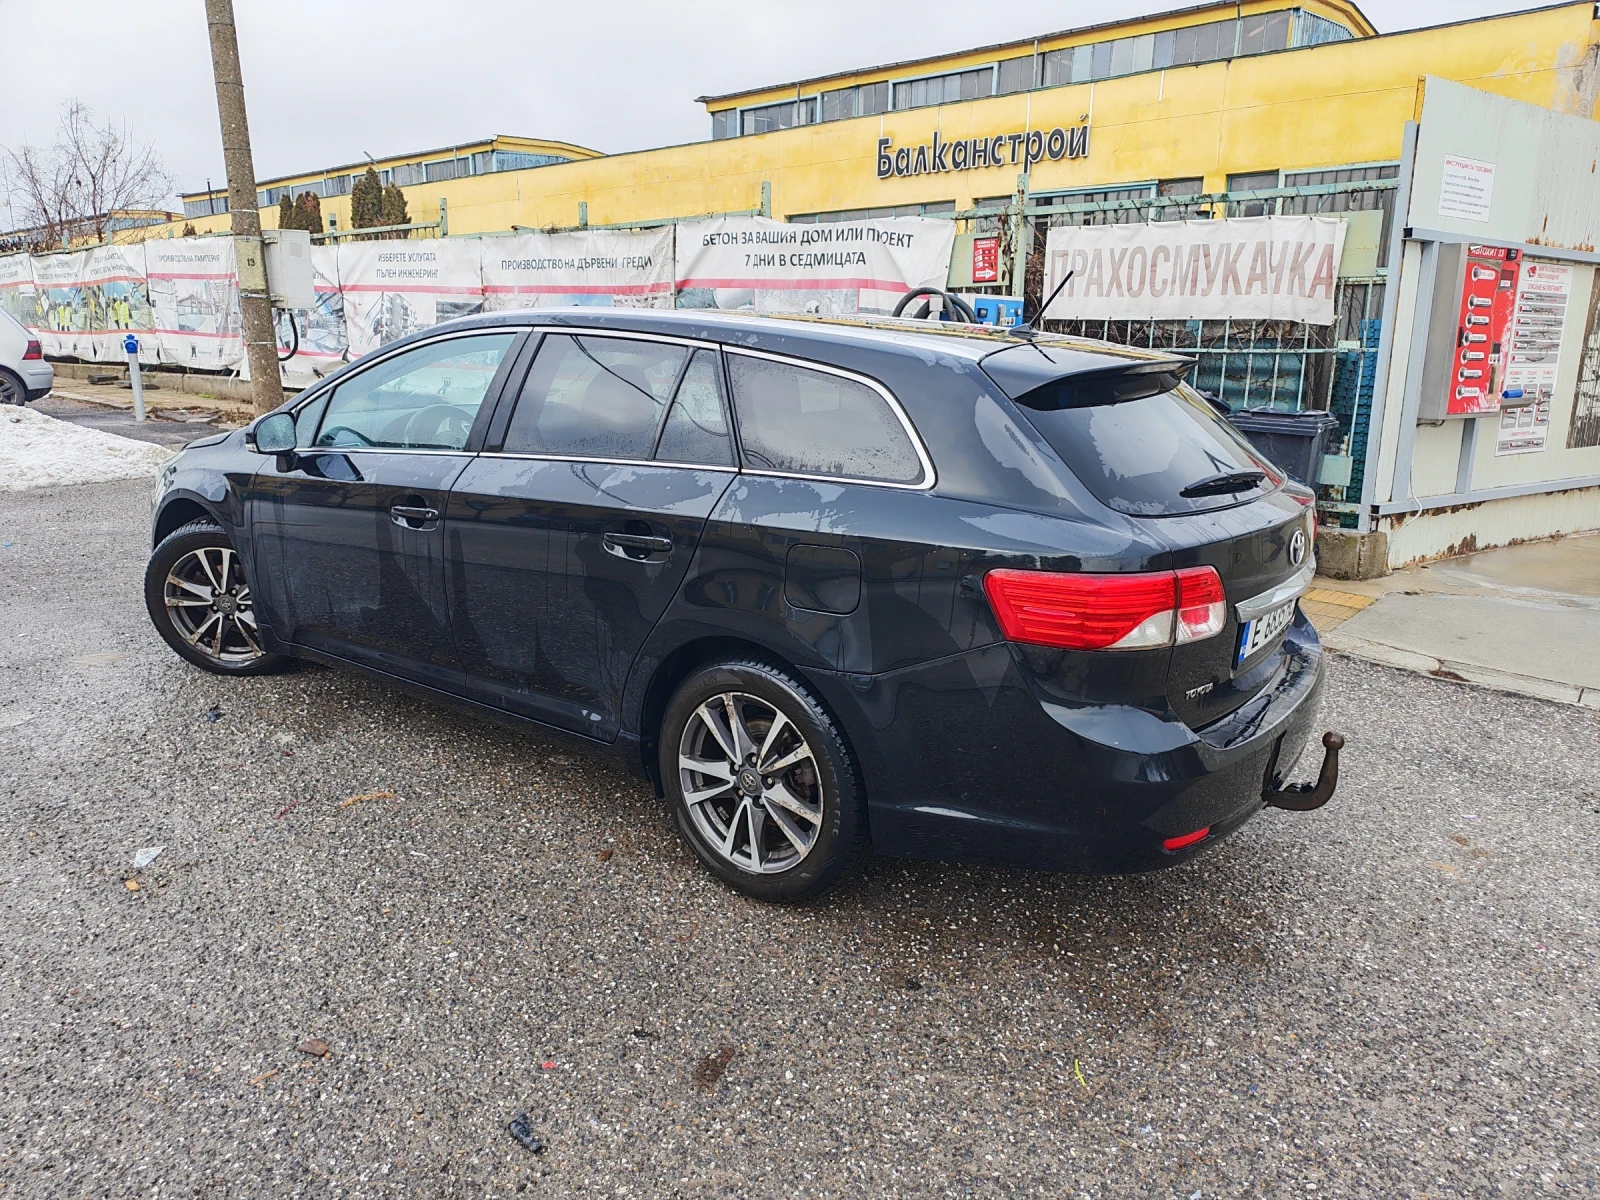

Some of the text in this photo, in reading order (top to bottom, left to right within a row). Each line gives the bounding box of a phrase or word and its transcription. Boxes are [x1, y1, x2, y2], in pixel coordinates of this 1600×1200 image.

[876, 113, 1091, 178] Балканстрой
[703, 232, 738, 246] БЕТОН
[741, 231, 754, 244] ЗА
[756, 230, 797, 244] ВАШИЯ
[800, 229, 832, 246] ДОМ
[836, 227, 863, 242] ИЛИ
[247, 258, 256, 267] 13
[378, 252, 437, 262] ИЗБЕРЕТЕ УСЛУГАТА
[501, 256, 652, 271] ПРОИЗВОДСТВО НА ДЪРВЕНИ ГРЕДИ
[745, 251, 866, 269] 7 ДНИ В СЕДМИЦАТА
[376, 268, 439, 278] ПЪЛЕН ИНЖЕНЕРИНГ
[1050, 239, 1334, 301] ПРАХОСМУКАЧКА
[1251, 616, 1263, 649] E
[1185, 682, 1214, 700] TOYOTA
